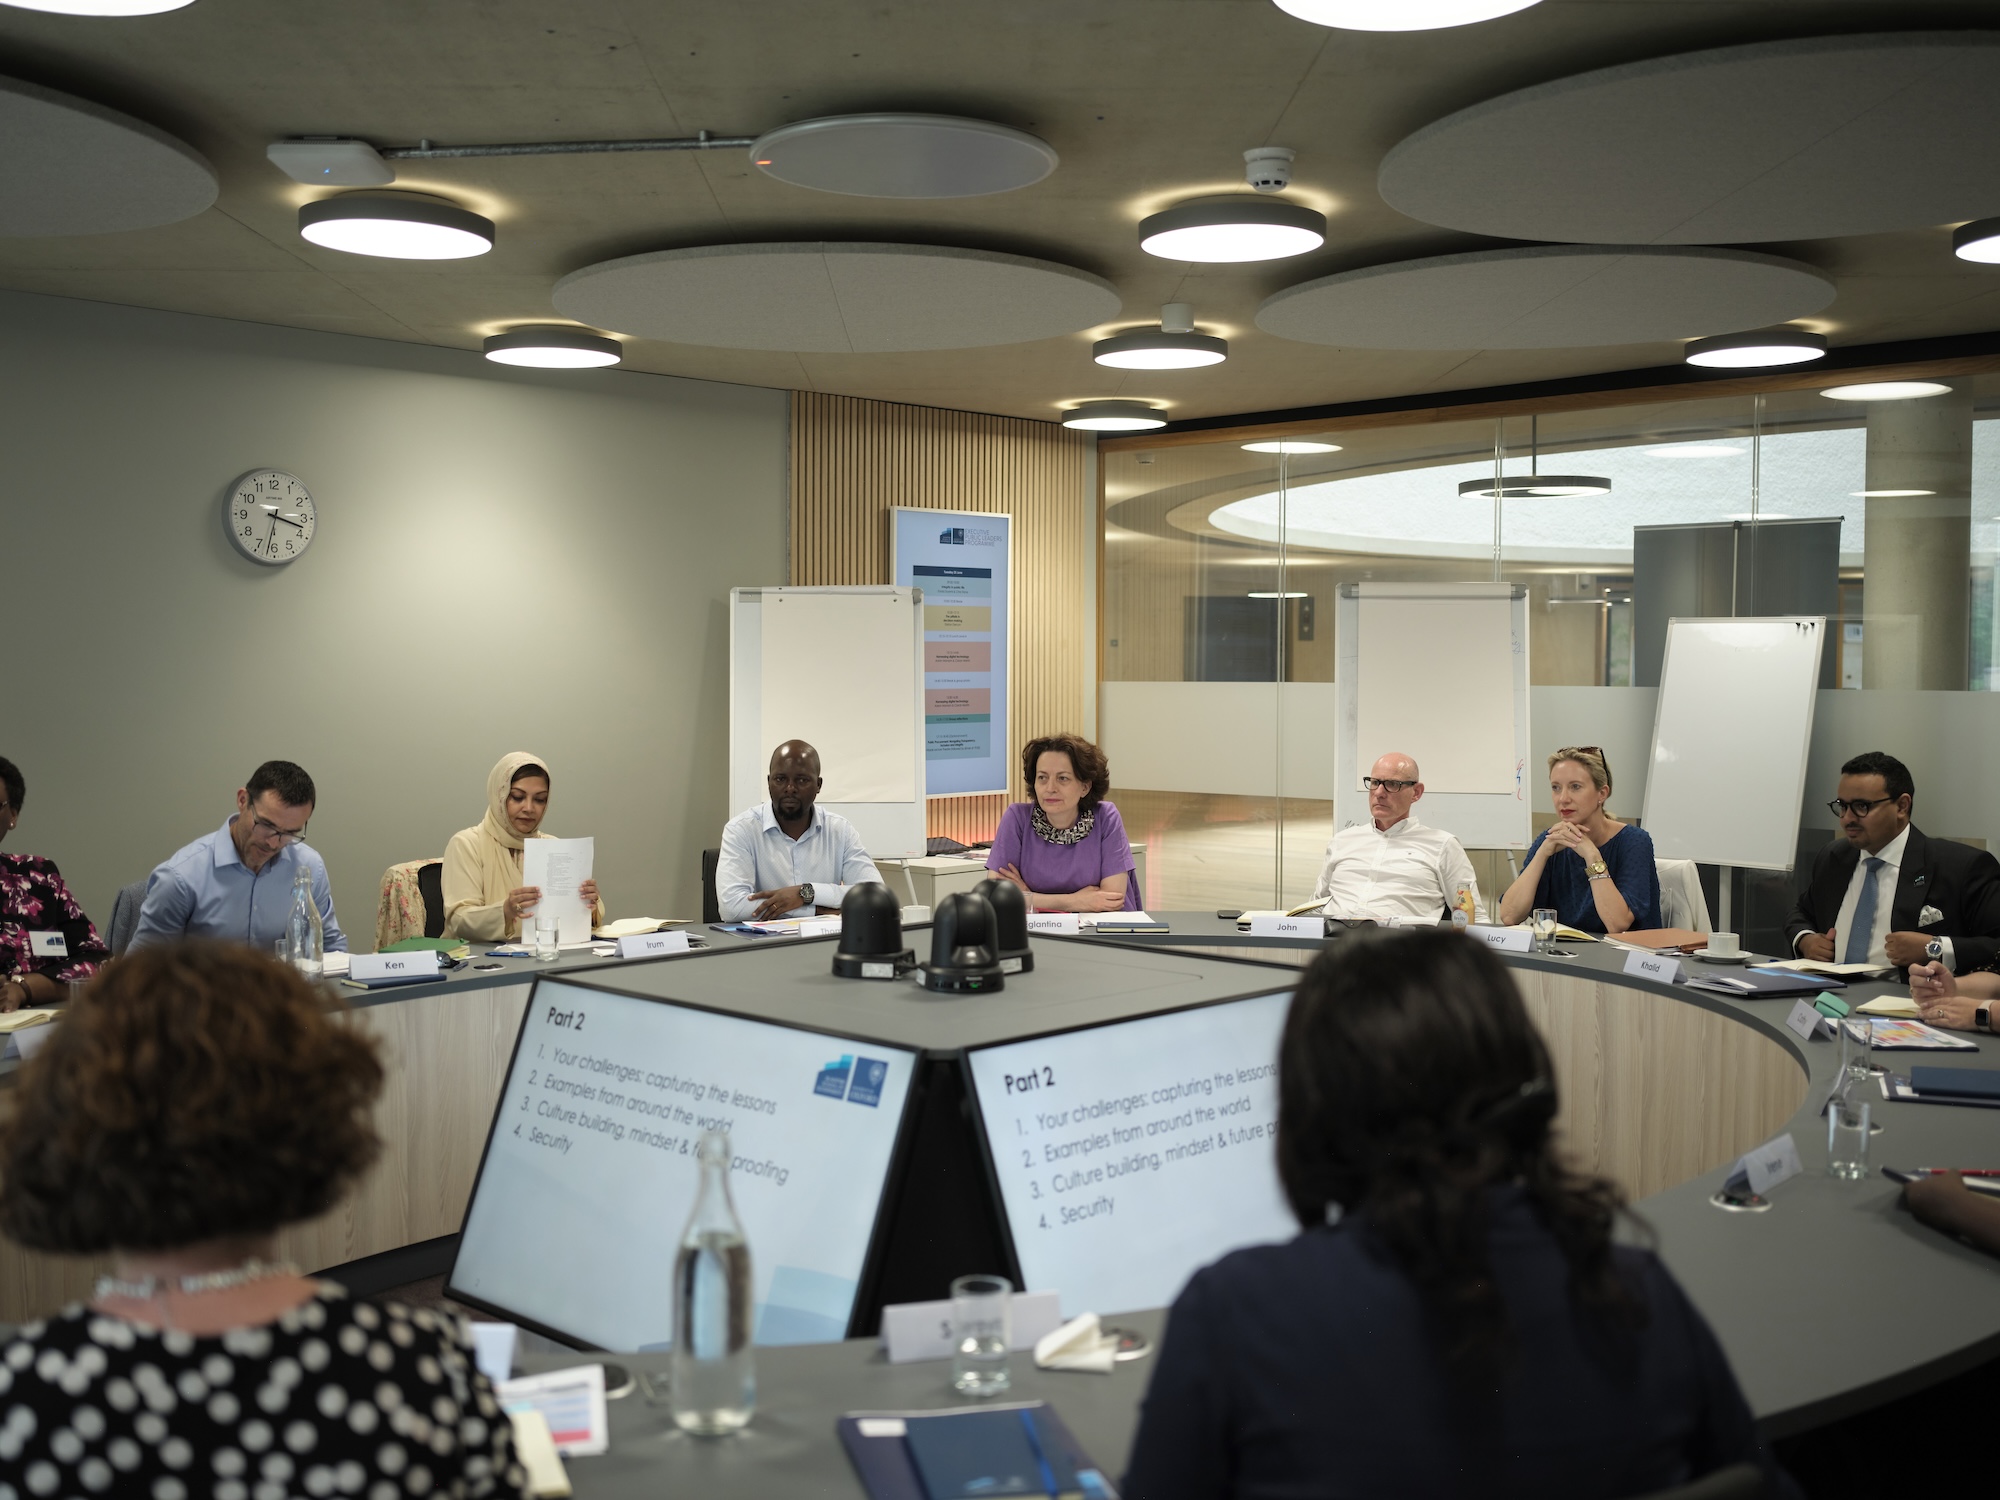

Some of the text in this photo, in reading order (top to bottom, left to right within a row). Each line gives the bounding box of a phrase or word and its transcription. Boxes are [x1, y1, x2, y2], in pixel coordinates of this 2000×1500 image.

[255, 482, 263, 493] 11
[269, 480, 280, 490] 12
[287, 485, 291, 494] 1
[243, 493, 255, 504] 10
[296, 497, 304, 507] 2
[240, 509, 248, 520] 9
[300, 513, 308, 523] 3
[244, 526, 252, 536] 8
[296, 529, 304, 539] 4
[255, 538, 263, 549] 7
[270, 543, 278, 553] 6
[285, 540, 293, 550] 5
[1026, 921, 1062, 929] glantina
[1277, 923, 1297, 931] John
[1487, 933, 1506, 944] Lucy
[646, 941, 664, 949] Irum
[385, 961, 405, 970] Ken
[1641, 961, 1661, 972] Khalid
[546, 1006, 585, 1031] Part 2
[537, 1043, 777, 1115] 1. Your challenges: capturing the lessons
[1004, 1066, 1055, 1095] Part 2
[528, 1069, 734, 1135] 2. Examples from around the world
[1016, 1063, 1277, 1136] 1. Your challenges: capturing the lessons
[1022, 1095, 1251, 1169] 2. Examples from around the world
[513, 1123, 573, 1155] 4. Security
[520, 1095, 530, 1112] 3.
[537, 1100, 577, 1124] Culture
[578, 1110, 625, 1141] building,
[629, 1127, 678, 1151] mindset
[678, 1139, 689, 1155] &
[730, 1155, 789, 1187] proofing
[1030, 1180, 1044, 1200] 3.
[1052, 1167, 1103, 1193] Culture
[1106, 1153, 1162, 1179] building,
[1165, 1134, 1214, 1162] mindset
[1217, 1132, 1227, 1148] &
[1229, 1124, 1263, 1144] future
[1039, 1195, 1115, 1229] 4. Security
